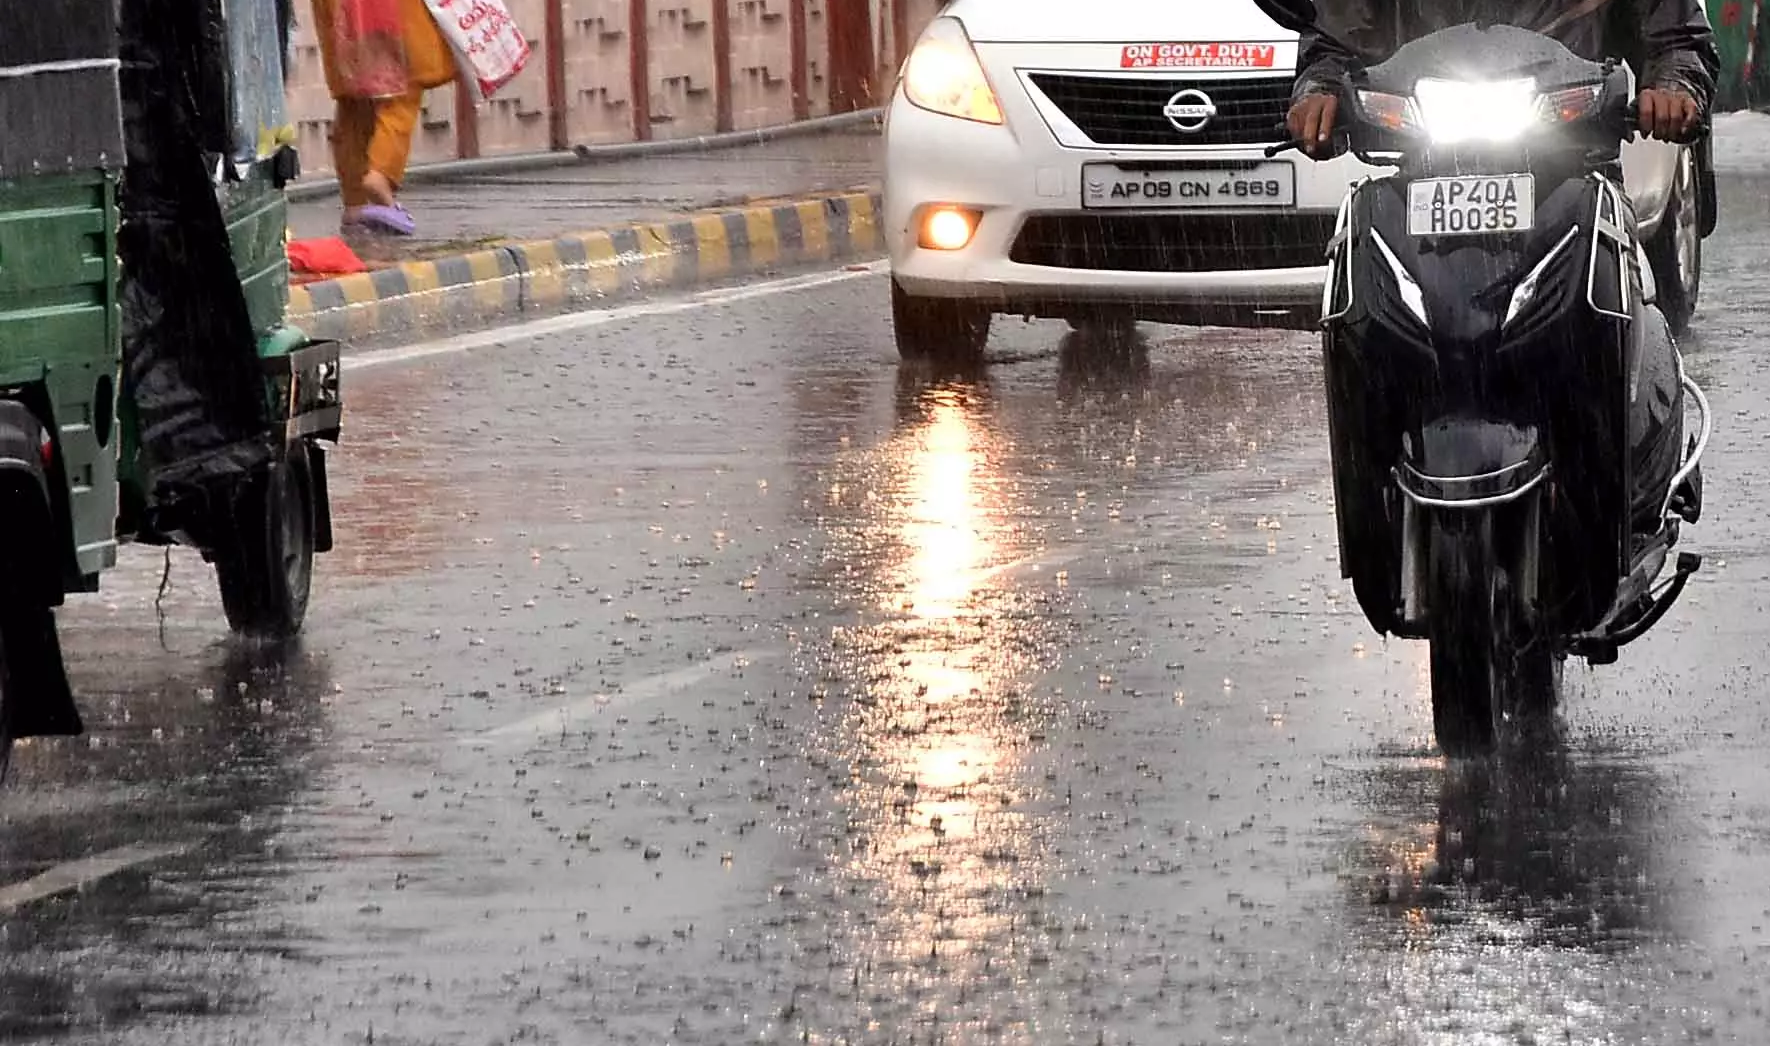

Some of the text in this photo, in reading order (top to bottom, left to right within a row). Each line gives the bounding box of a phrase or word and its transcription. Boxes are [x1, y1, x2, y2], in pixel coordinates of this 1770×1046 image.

[1127, 44, 1271, 58] ON GOVT. DUTY
[1132, 56, 1256, 67] AP SECRETARIAT
[1110, 181, 1172, 198] AP09
[1217, 180, 1280, 197] 4669
[1432, 179, 1517, 205] AP40A
[1432, 206, 1517, 232] H0035
